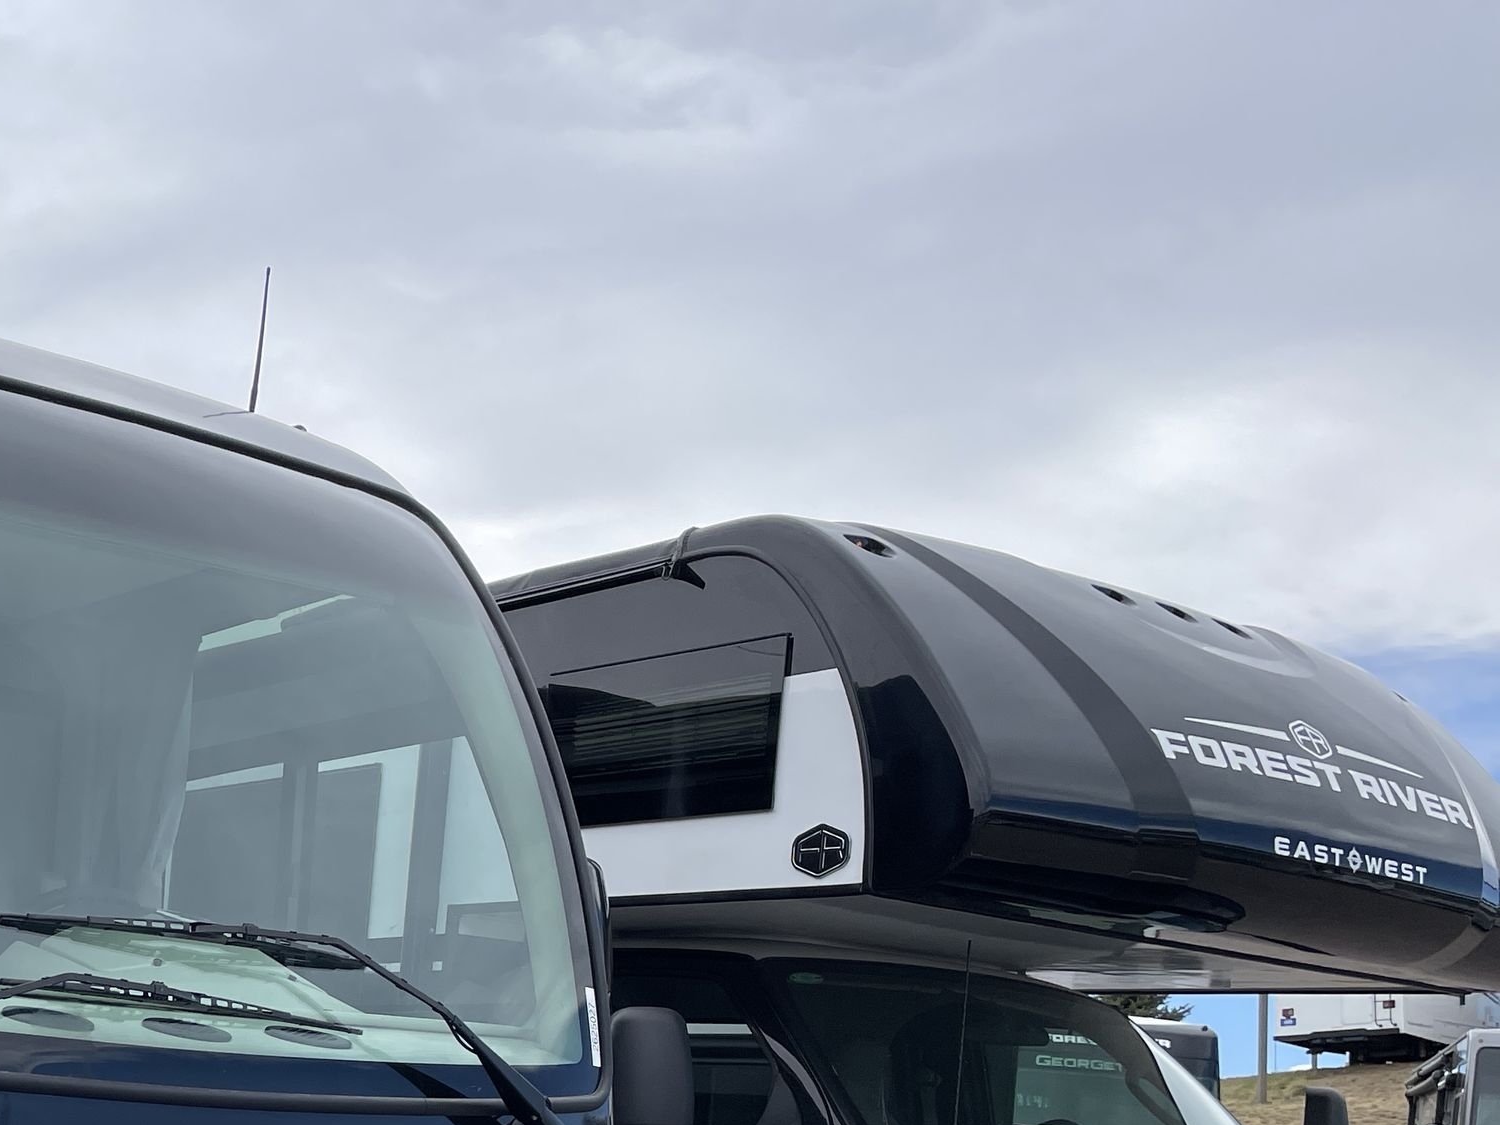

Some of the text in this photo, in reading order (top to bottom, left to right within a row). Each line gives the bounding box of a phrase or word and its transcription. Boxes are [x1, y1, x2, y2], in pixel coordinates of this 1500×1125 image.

[1151, 728, 1473, 829] FOREST RIVER
[1274, 836, 1428, 885] EAST WEST
